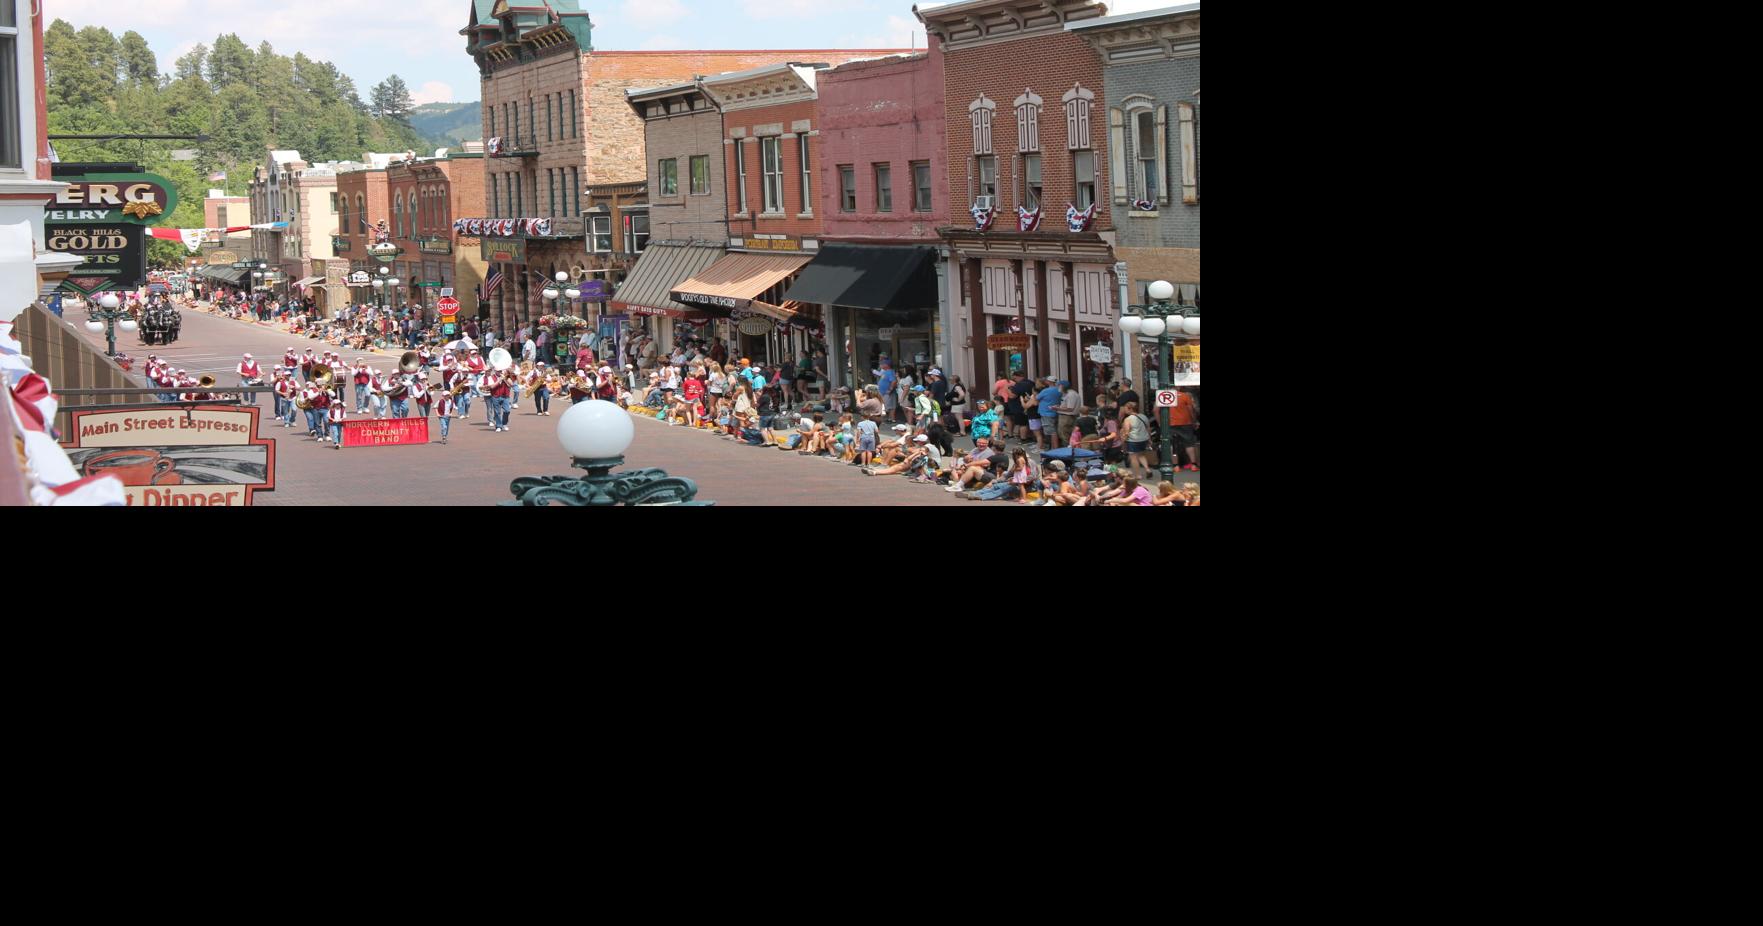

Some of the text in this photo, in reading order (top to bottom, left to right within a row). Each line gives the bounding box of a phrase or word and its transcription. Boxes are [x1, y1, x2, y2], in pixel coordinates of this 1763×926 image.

[93, 228, 121, 236] HILLS
[48, 235, 128, 250] GOLD
[81, 415, 249, 438] Main Street Espresso
[345, 420, 390, 429] NORTHERN
[361, 428, 409, 437] COMMUNITY
[374, 436, 400, 444] BAND
